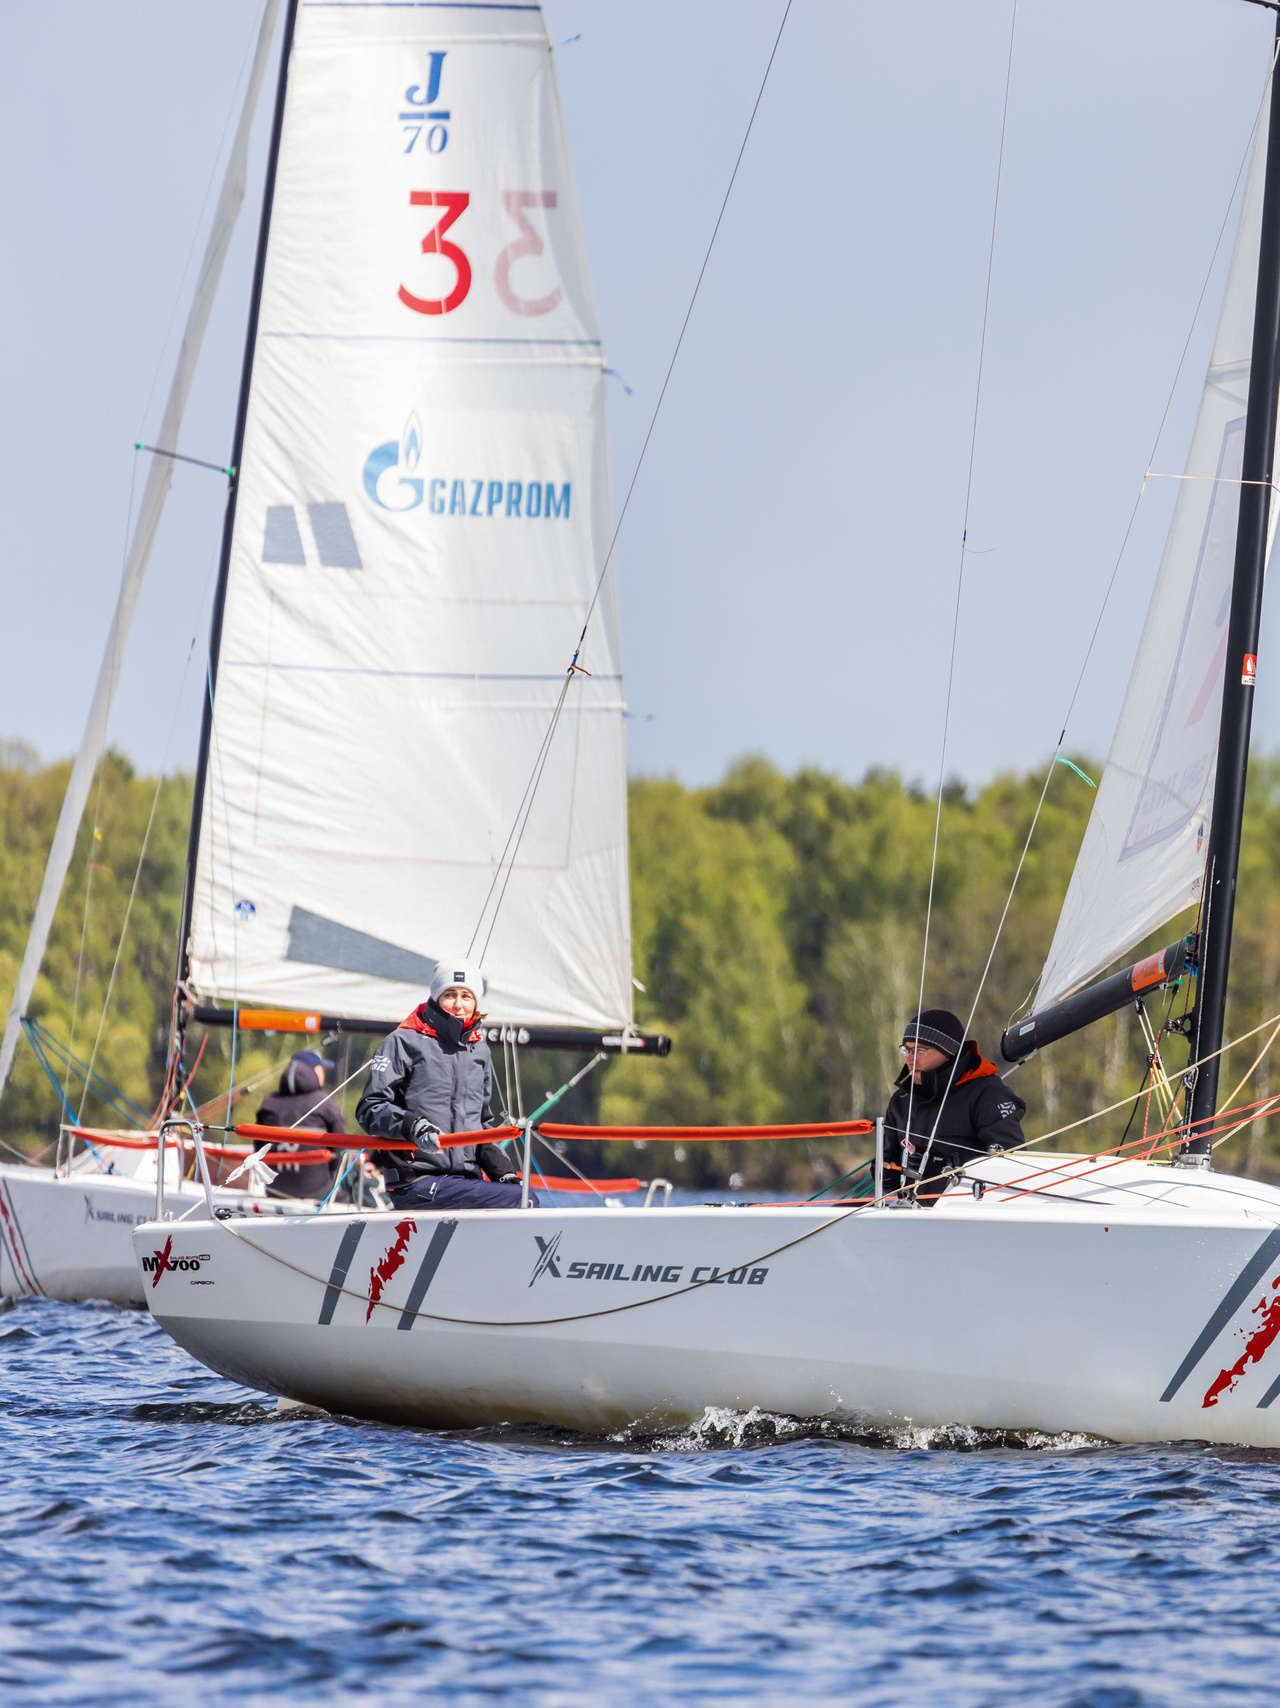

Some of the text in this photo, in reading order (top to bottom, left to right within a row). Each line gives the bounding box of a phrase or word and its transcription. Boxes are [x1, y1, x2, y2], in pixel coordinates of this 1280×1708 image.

[404, 51, 448, 106] J
[403, 124, 448, 154] 70
[397, 190, 472, 316] 3
[428, 478, 572, 520] GAZPROM
[566, 1261, 683, 1283] SAILING
[689, 1266, 769, 1285] CLUB
